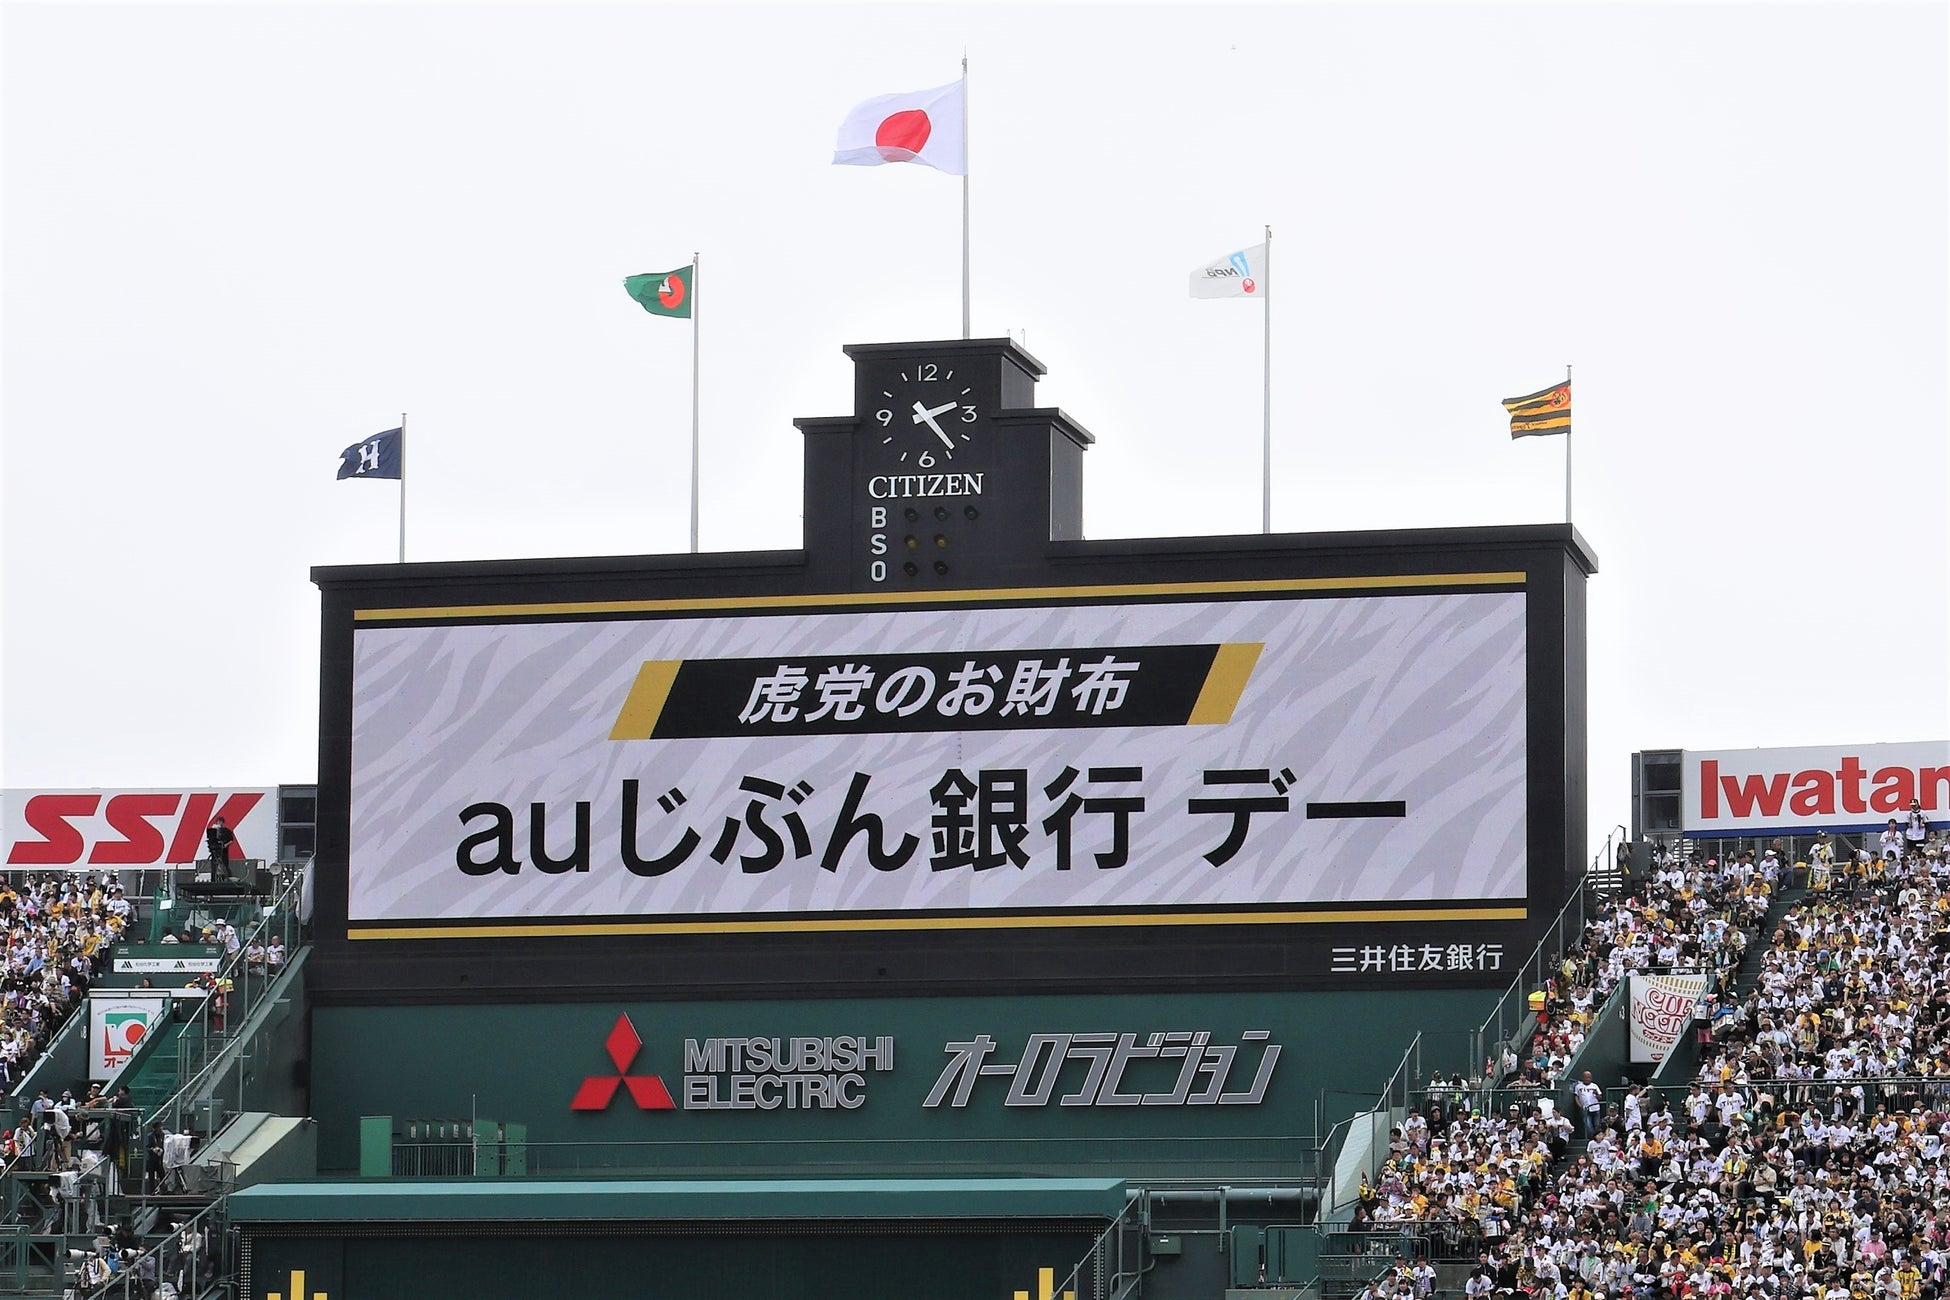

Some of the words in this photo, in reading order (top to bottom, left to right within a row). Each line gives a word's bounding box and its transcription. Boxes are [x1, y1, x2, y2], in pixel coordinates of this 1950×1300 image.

[919, 364, 937, 382] 12
[875, 409, 892, 426] 9
[962, 405, 977, 422] 3
[919, 450, 935, 467] 6
[868, 472, 984, 498] CITIZEN
[871, 507, 887, 528] B
[871, 534, 887, 554] S
[871, 561, 886, 582] O
[737, 654, 1141, 726] 虎党のお財布
[1701, 757, 1950, 819] Iwatan
[7, 793, 264, 864] SSK
[1189, 767, 1406, 867] デー
[1331, 943, 1504, 972] 三井住友銀行
[684, 1035, 894, 1074] MITSUBISHI
[922, 1030, 1283, 1108] オーロラビジョン
[684, 1073, 866, 1110] ELECTRIC
